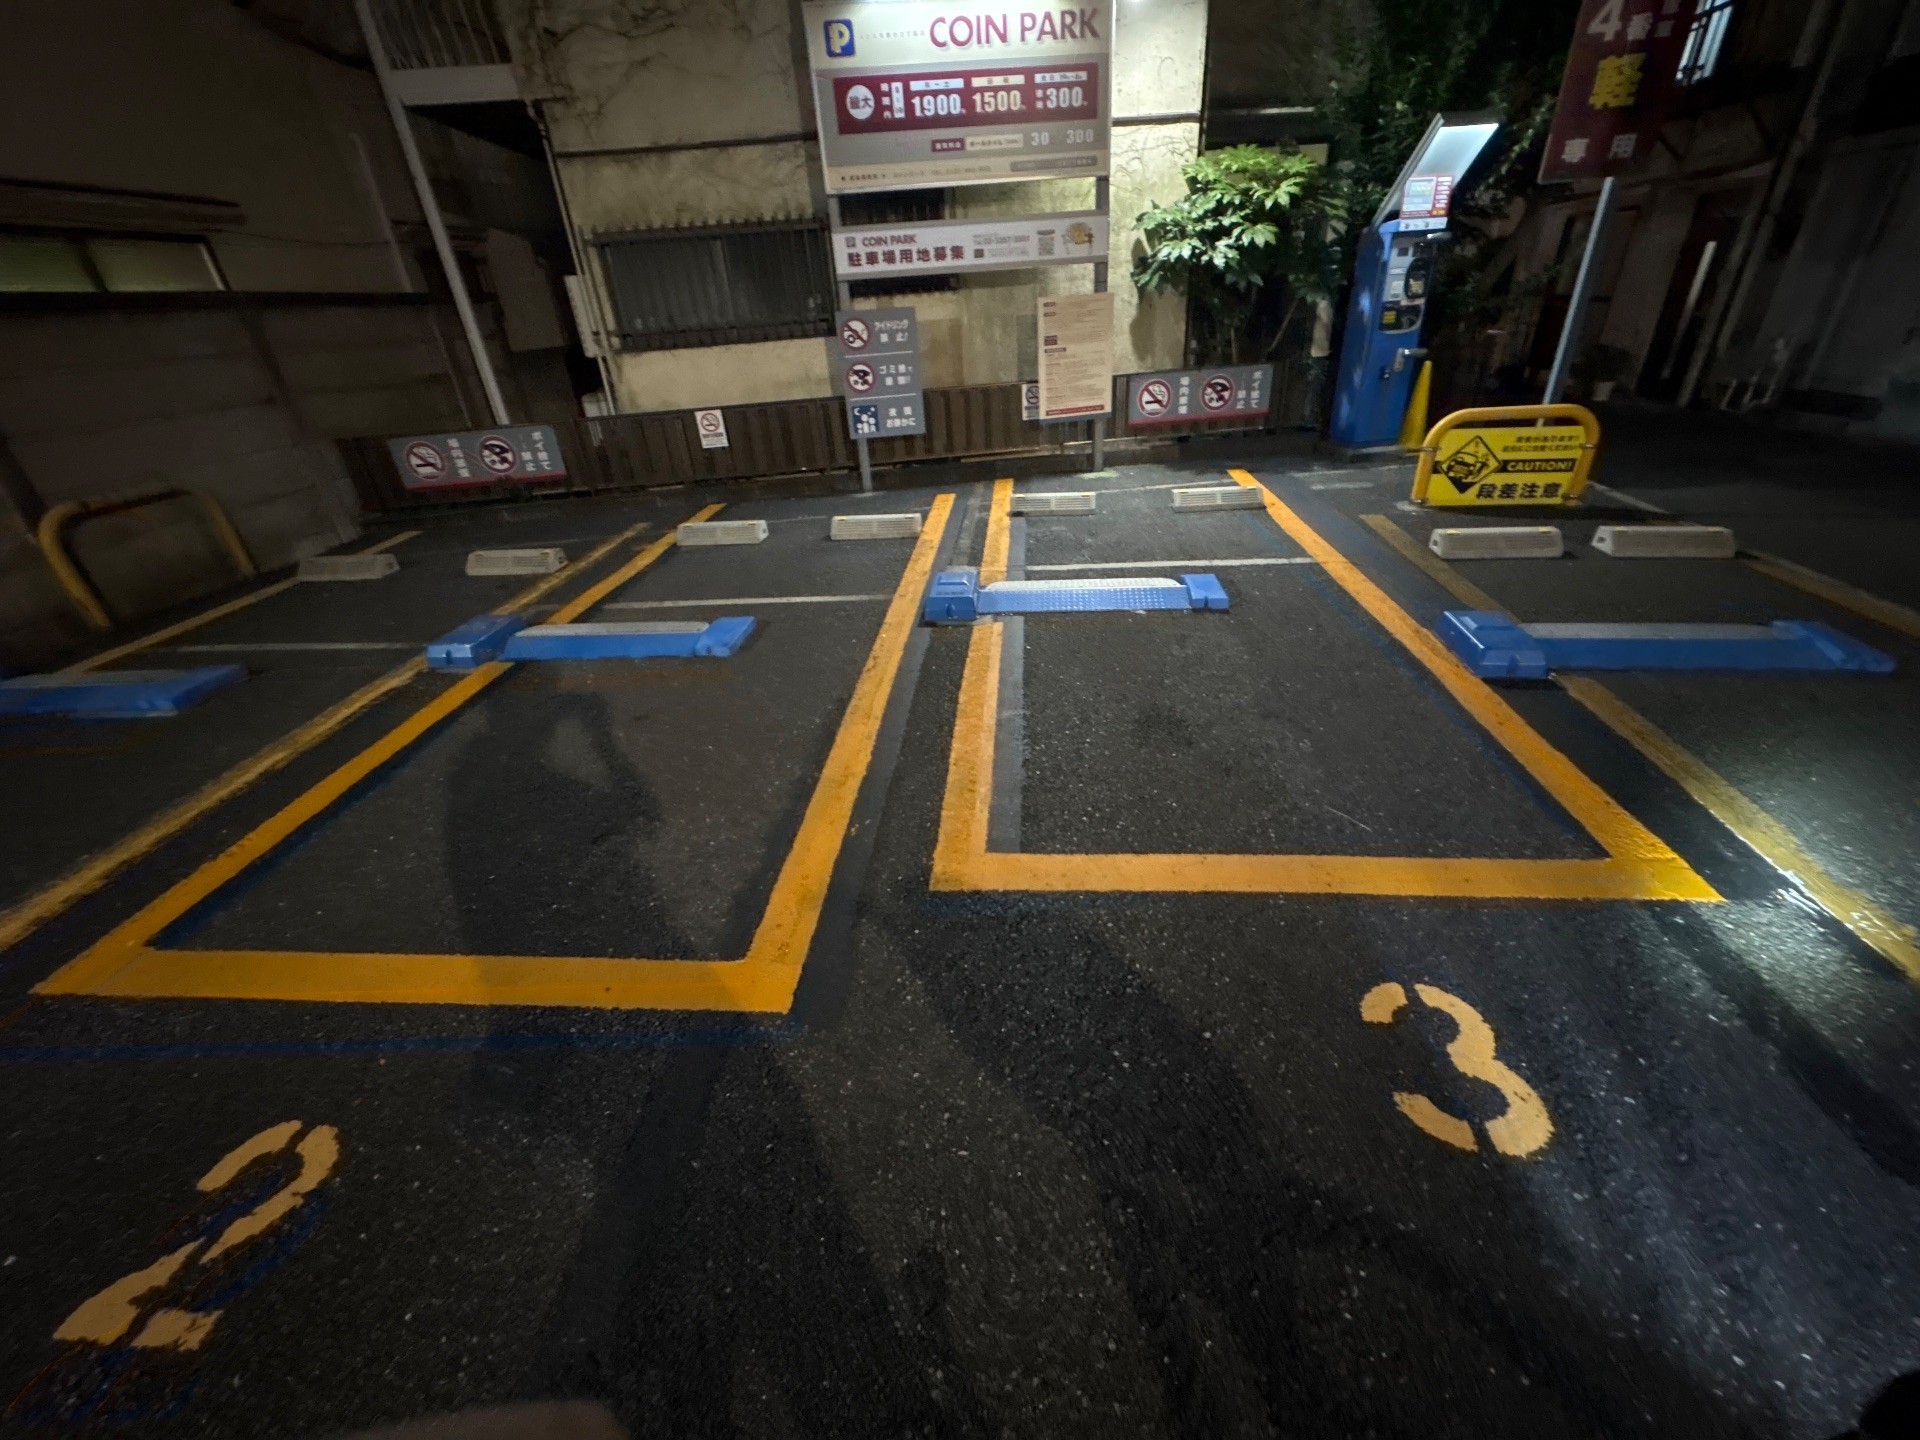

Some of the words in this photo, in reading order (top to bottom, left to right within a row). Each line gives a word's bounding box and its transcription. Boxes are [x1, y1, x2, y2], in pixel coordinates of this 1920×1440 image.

[930, 14, 1008, 48] COIN
[1020, 8, 1101, 42] PARK
[1031, 131, 1050, 146] 30
[1066, 129, 1094, 144] 300
[862, 236, 889, 247] COIN
[890, 234, 917, 245] PARK
[847, 244, 965, 268] 駐車場用地募集
[1507, 460, 1573, 471] CAUTION!
[1477, 483, 1562, 499] 段差注意
[1359, 981, 1555, 1158] 3
[53, 1119, 340, 1351] 2
